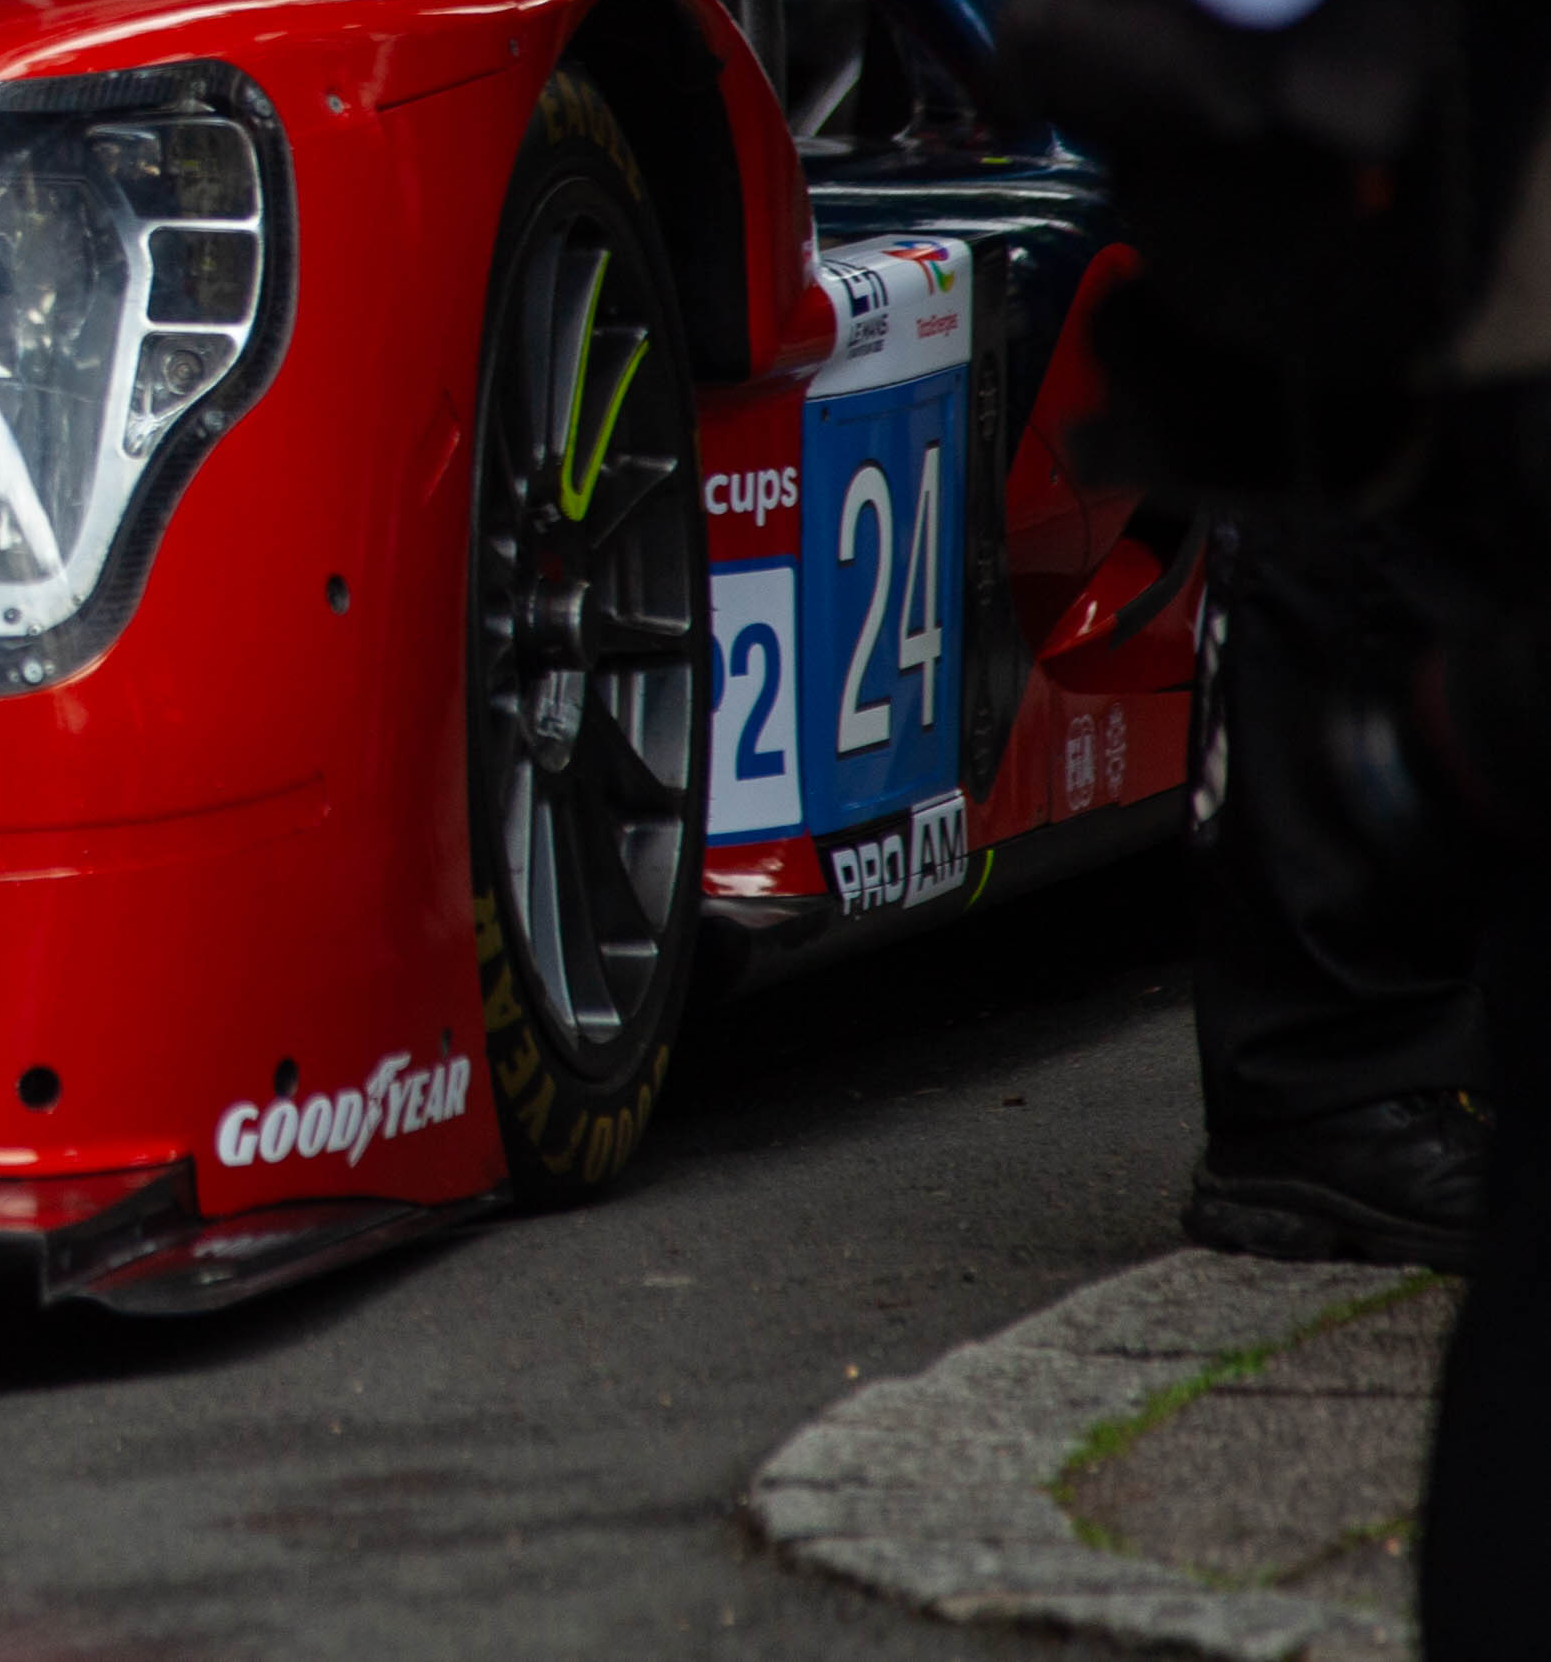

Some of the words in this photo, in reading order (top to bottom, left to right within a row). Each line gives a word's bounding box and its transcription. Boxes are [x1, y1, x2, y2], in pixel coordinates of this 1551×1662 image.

[704, 465, 799, 528] cups
[836, 440, 942, 760] 24
[709, 622, 787, 782] 2
[831, 833, 906, 916] PRO
[918, 807, 966, 893] AM
